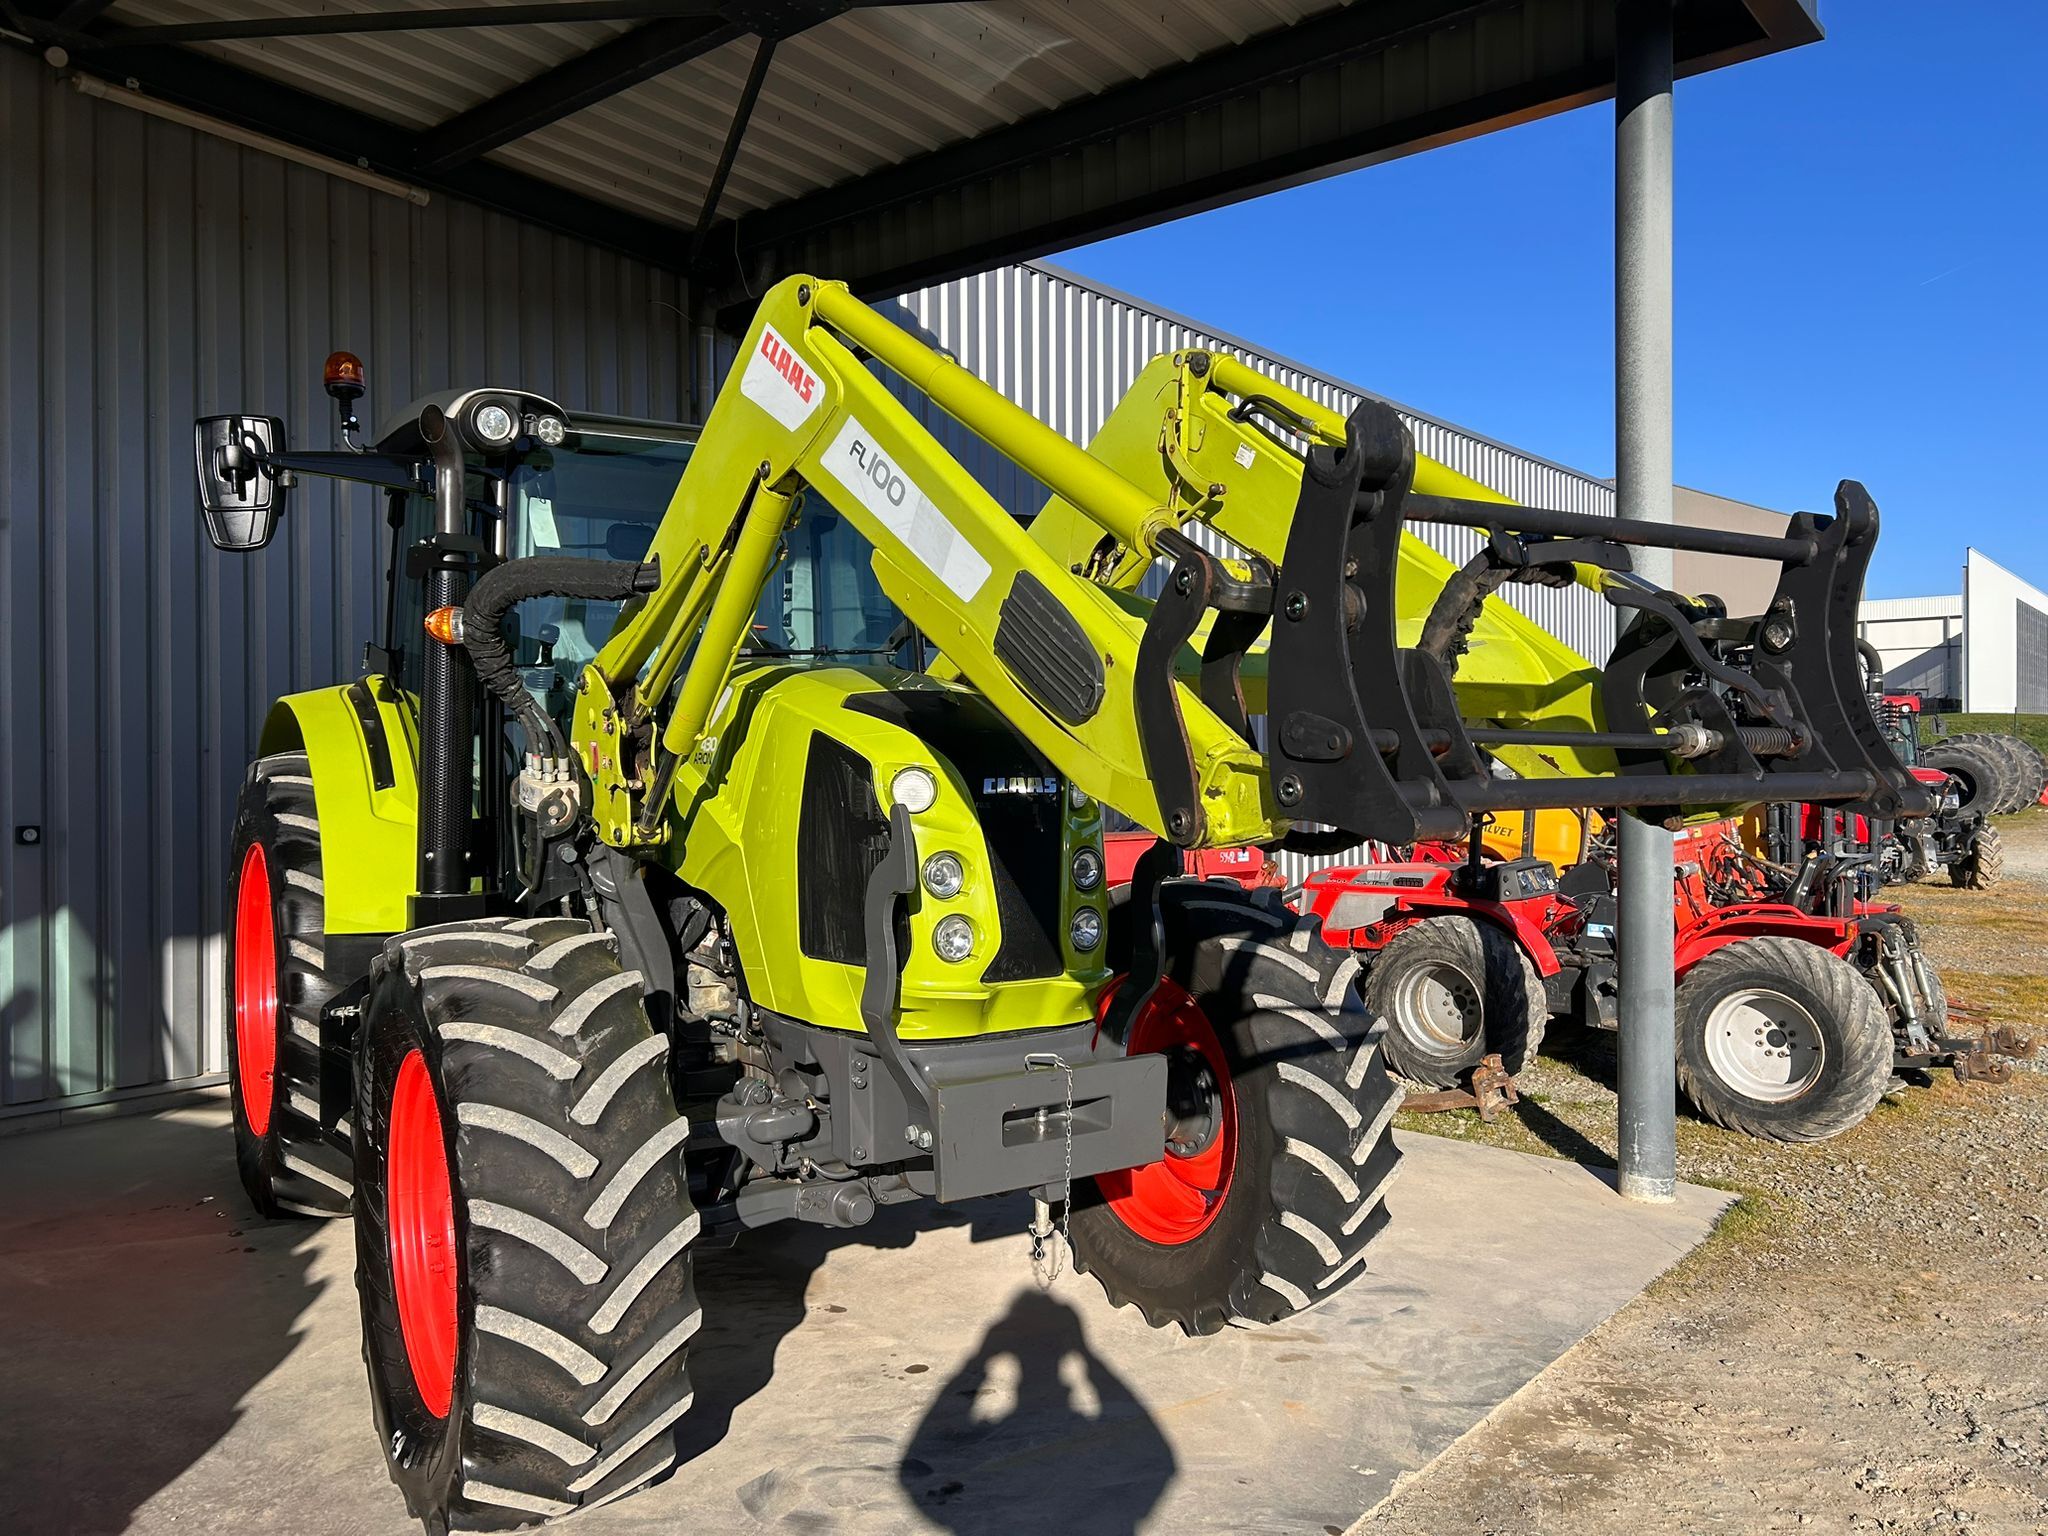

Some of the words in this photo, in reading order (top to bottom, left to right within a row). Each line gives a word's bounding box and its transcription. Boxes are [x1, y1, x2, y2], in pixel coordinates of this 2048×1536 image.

[761, 331, 816, 404] CLAAS
[983, 777, 1057, 795] CLAAS
[1482, 825, 1514, 837] ALVET
